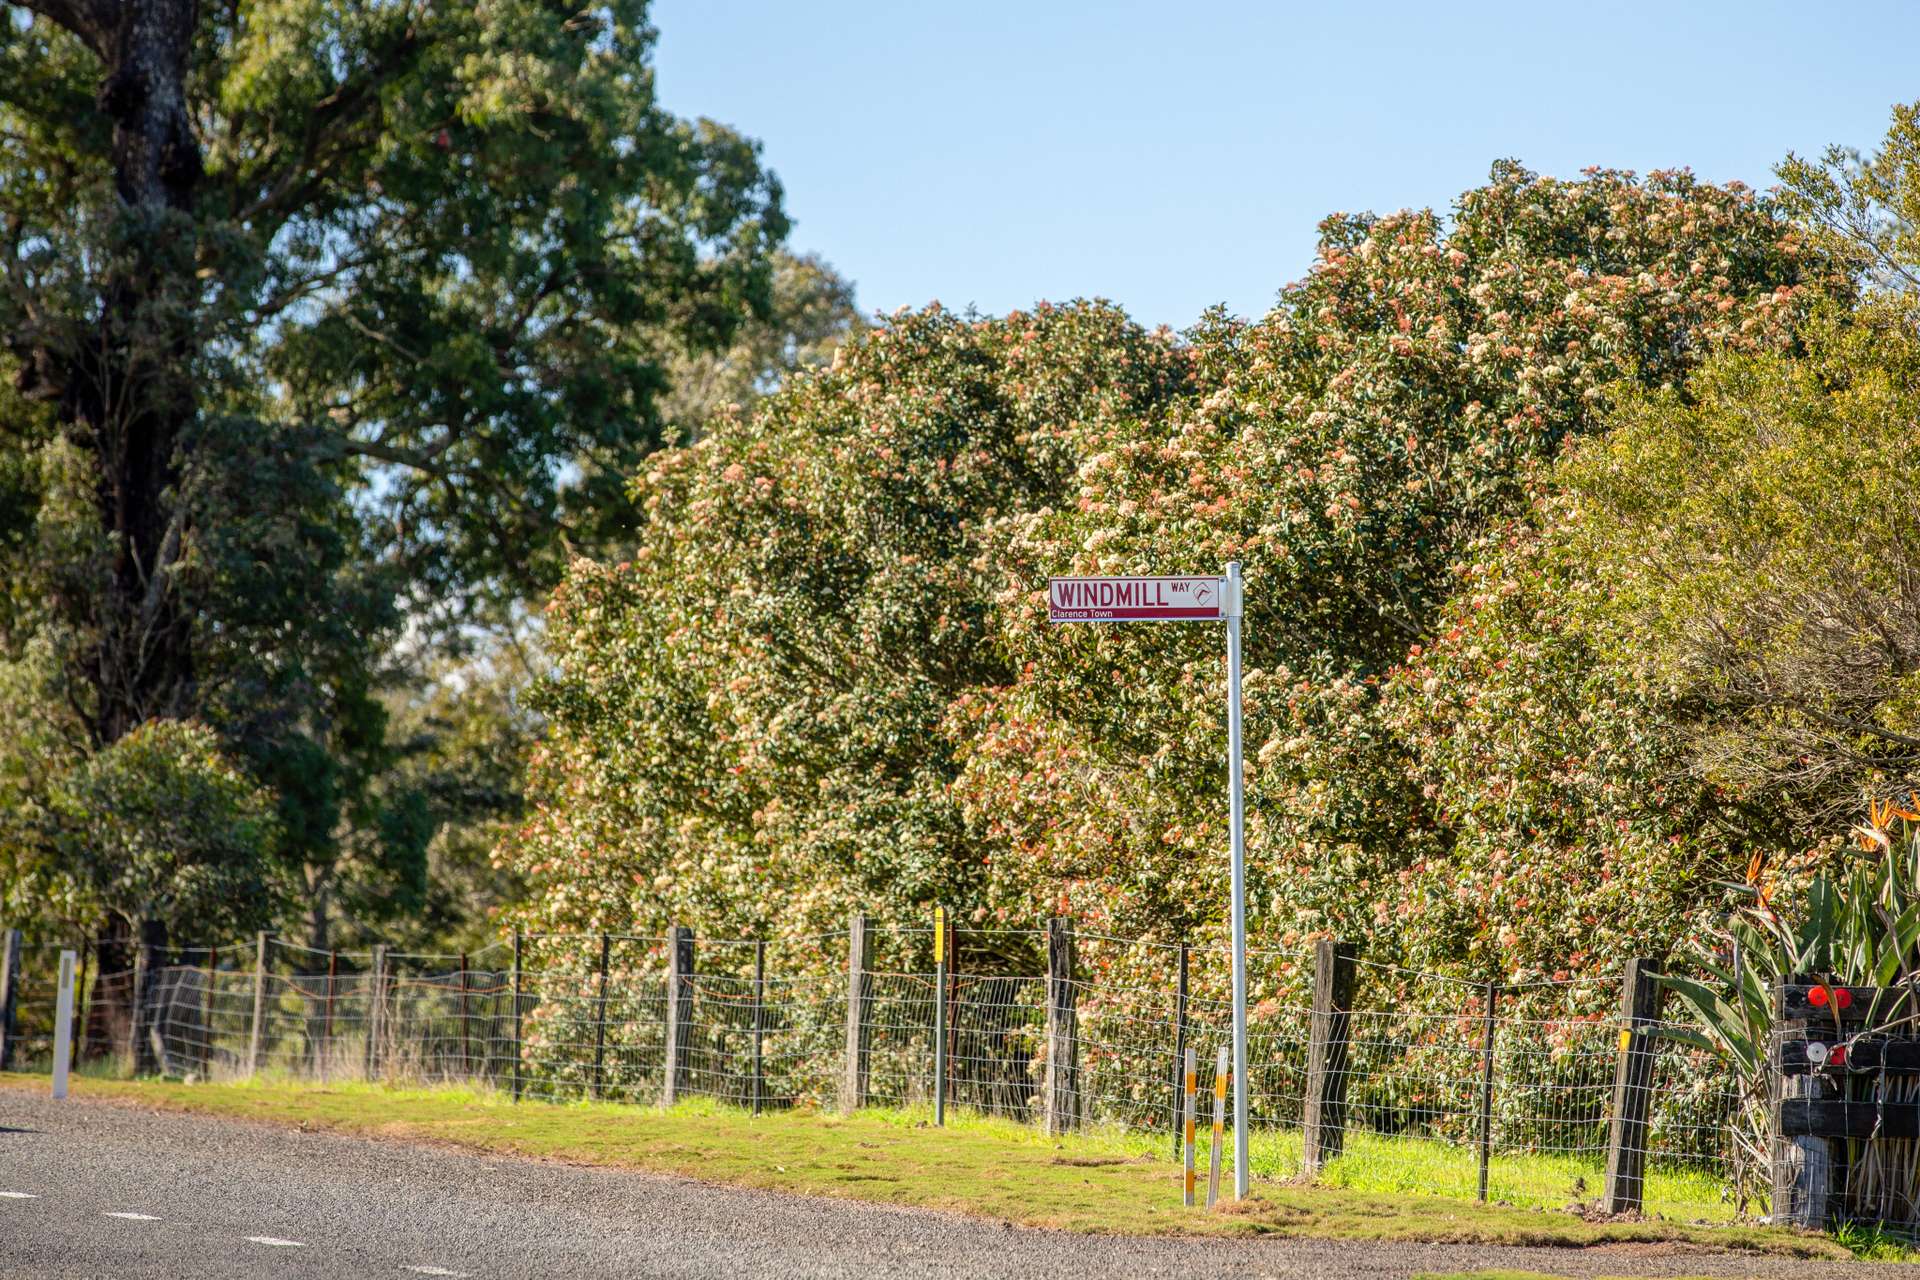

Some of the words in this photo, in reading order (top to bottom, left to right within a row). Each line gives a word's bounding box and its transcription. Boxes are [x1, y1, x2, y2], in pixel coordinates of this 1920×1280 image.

[1057, 583, 1169, 607] WINDMILL
[1171, 582, 1191, 592] WAY
[1051, 610, 1088, 618] Clarence
[1090, 610, 1112, 618] Town
